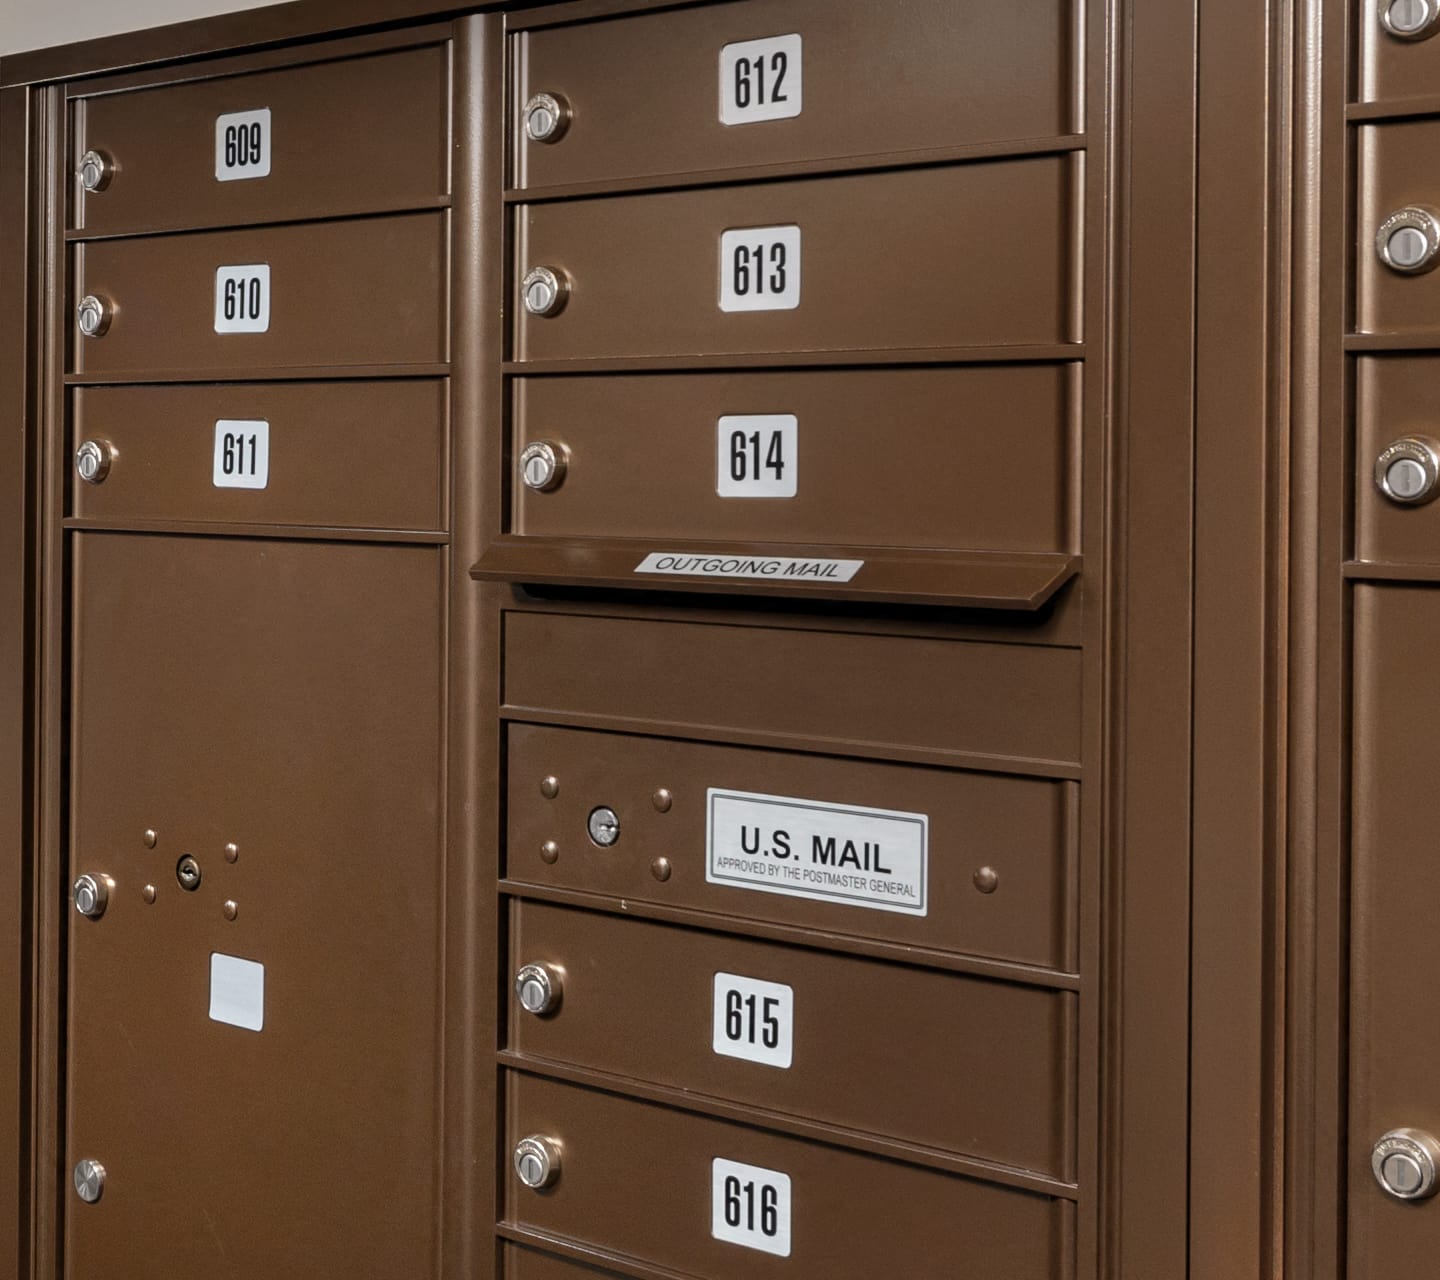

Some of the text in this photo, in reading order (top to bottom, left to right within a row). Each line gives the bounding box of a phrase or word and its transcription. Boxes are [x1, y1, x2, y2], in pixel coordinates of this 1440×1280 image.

[734, 51, 788, 109] 612
[224, 121, 262, 168] 609
[733, 241, 787, 297] 613
[223, 276, 261, 321] 610
[222, 432, 257, 476] 611
[730, 430, 785, 482] 614
[656, 557, 840, 578] OUTGOING MAIL
[741, 825, 892, 875] U.S. MAIL
[717, 856, 916, 898] APPROVED BY THE POSTMASTER GENERAL
[725, 989, 780, 1049] 615
[724, 1175, 778, 1237] 616
